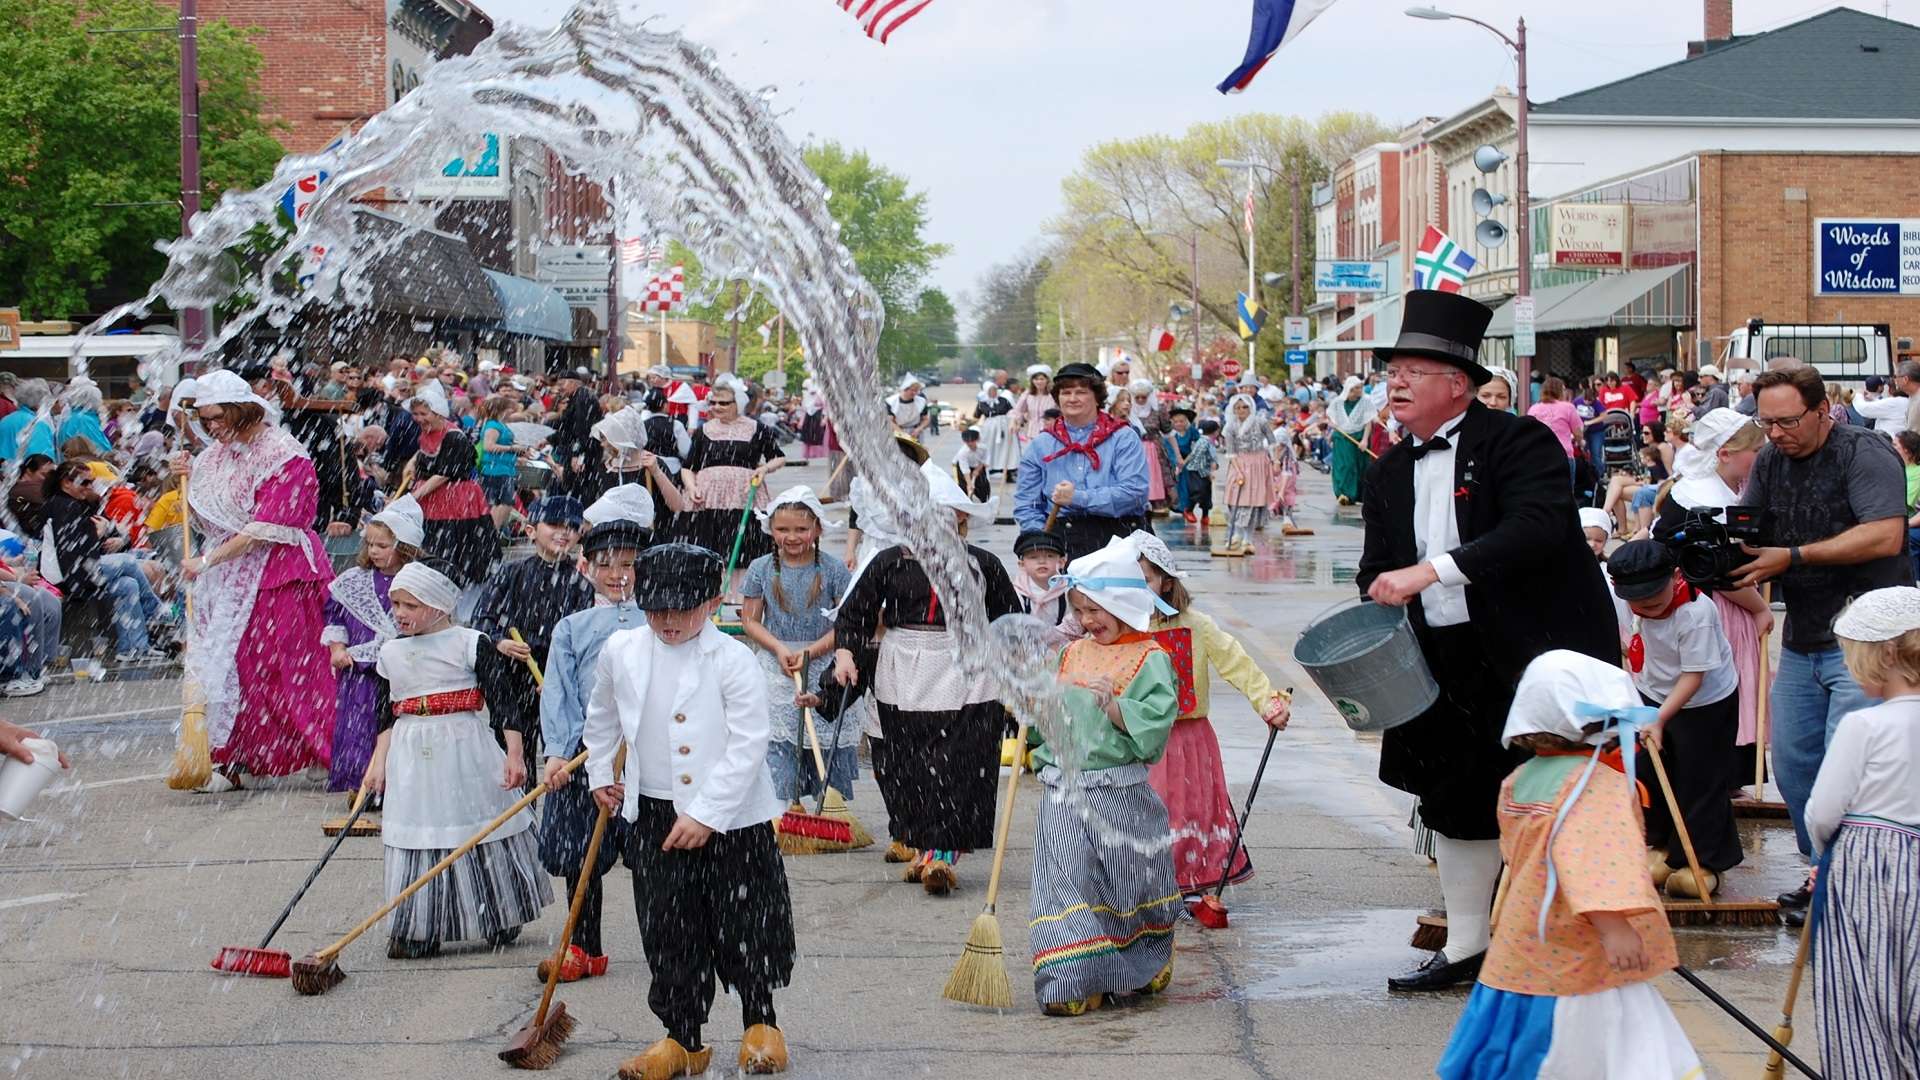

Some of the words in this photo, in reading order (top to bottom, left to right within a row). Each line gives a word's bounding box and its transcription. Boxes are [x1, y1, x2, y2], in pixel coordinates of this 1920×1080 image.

[1559, 207, 1599, 221] WORDS
[1558, 237, 1604, 251] WISDOM
[1829, 226, 1891, 246] Words
[1850, 246, 1871, 271] of
[1825, 269, 1897, 289] Wisdom
[1221, 364, 1240, 373] STOP
